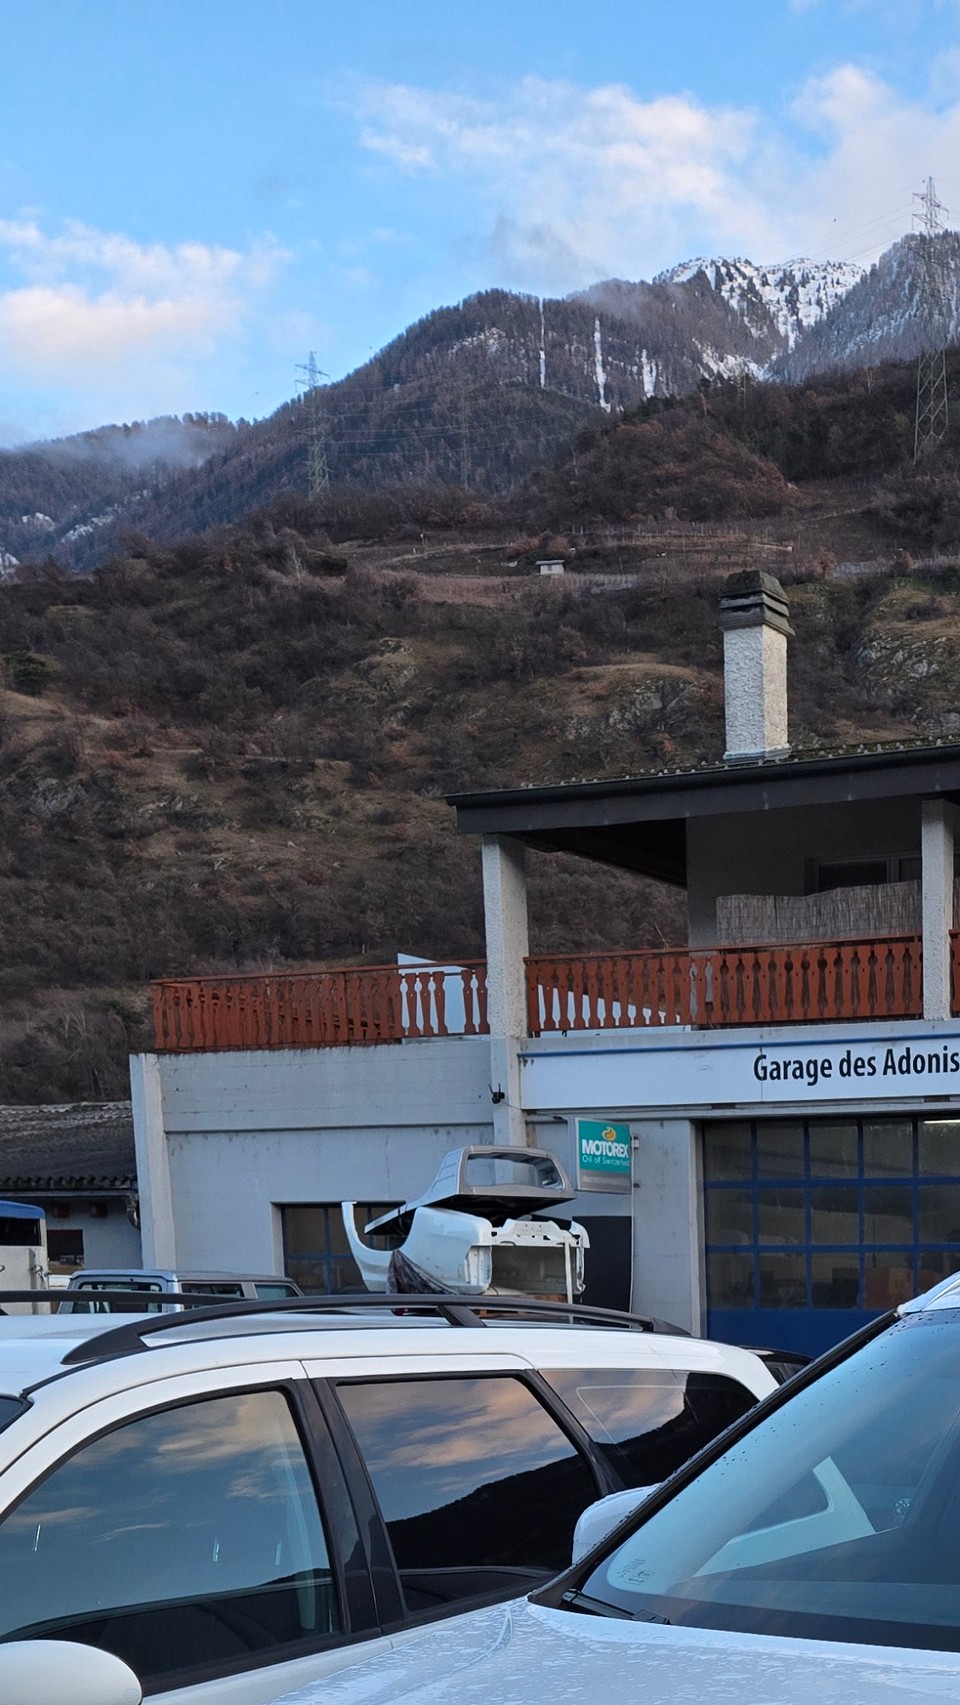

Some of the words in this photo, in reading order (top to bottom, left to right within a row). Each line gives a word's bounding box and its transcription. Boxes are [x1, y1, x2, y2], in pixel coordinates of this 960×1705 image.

[753, 1053, 833, 1086] Garage
[839, 1050, 877, 1077] des
[882, 1044, 960, 1076] Adonis
[581, 1139, 629, 1158] MOTOREX
[582, 1154, 593, 1163] Oil
